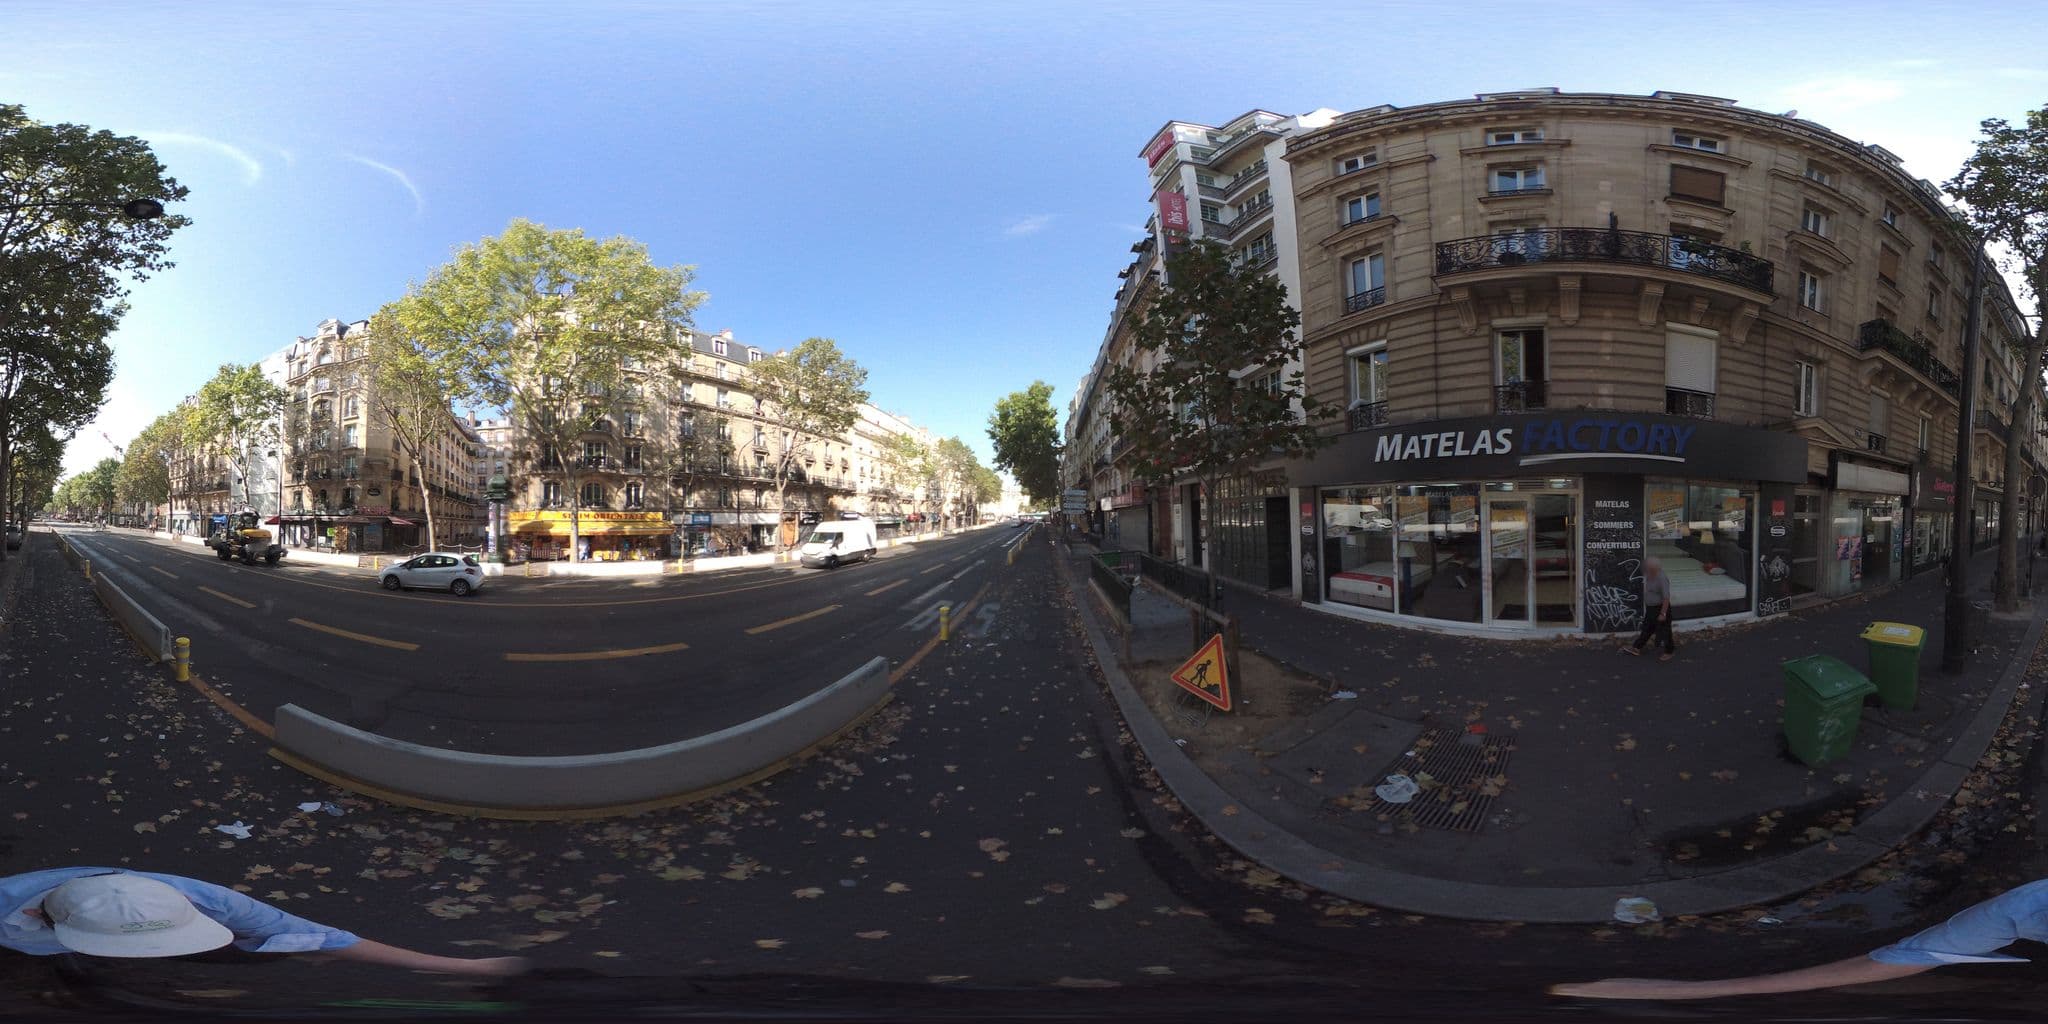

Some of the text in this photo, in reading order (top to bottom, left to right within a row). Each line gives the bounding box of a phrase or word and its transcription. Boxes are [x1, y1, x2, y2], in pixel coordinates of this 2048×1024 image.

[1374, 419, 1697, 463] MATELAS FACTORY
[1595, 500, 1629, 508] MATELAS
[1593, 521, 1634, 529] SOMMIERS
[1586, 541, 1641, 549] CONVERTIBLES
